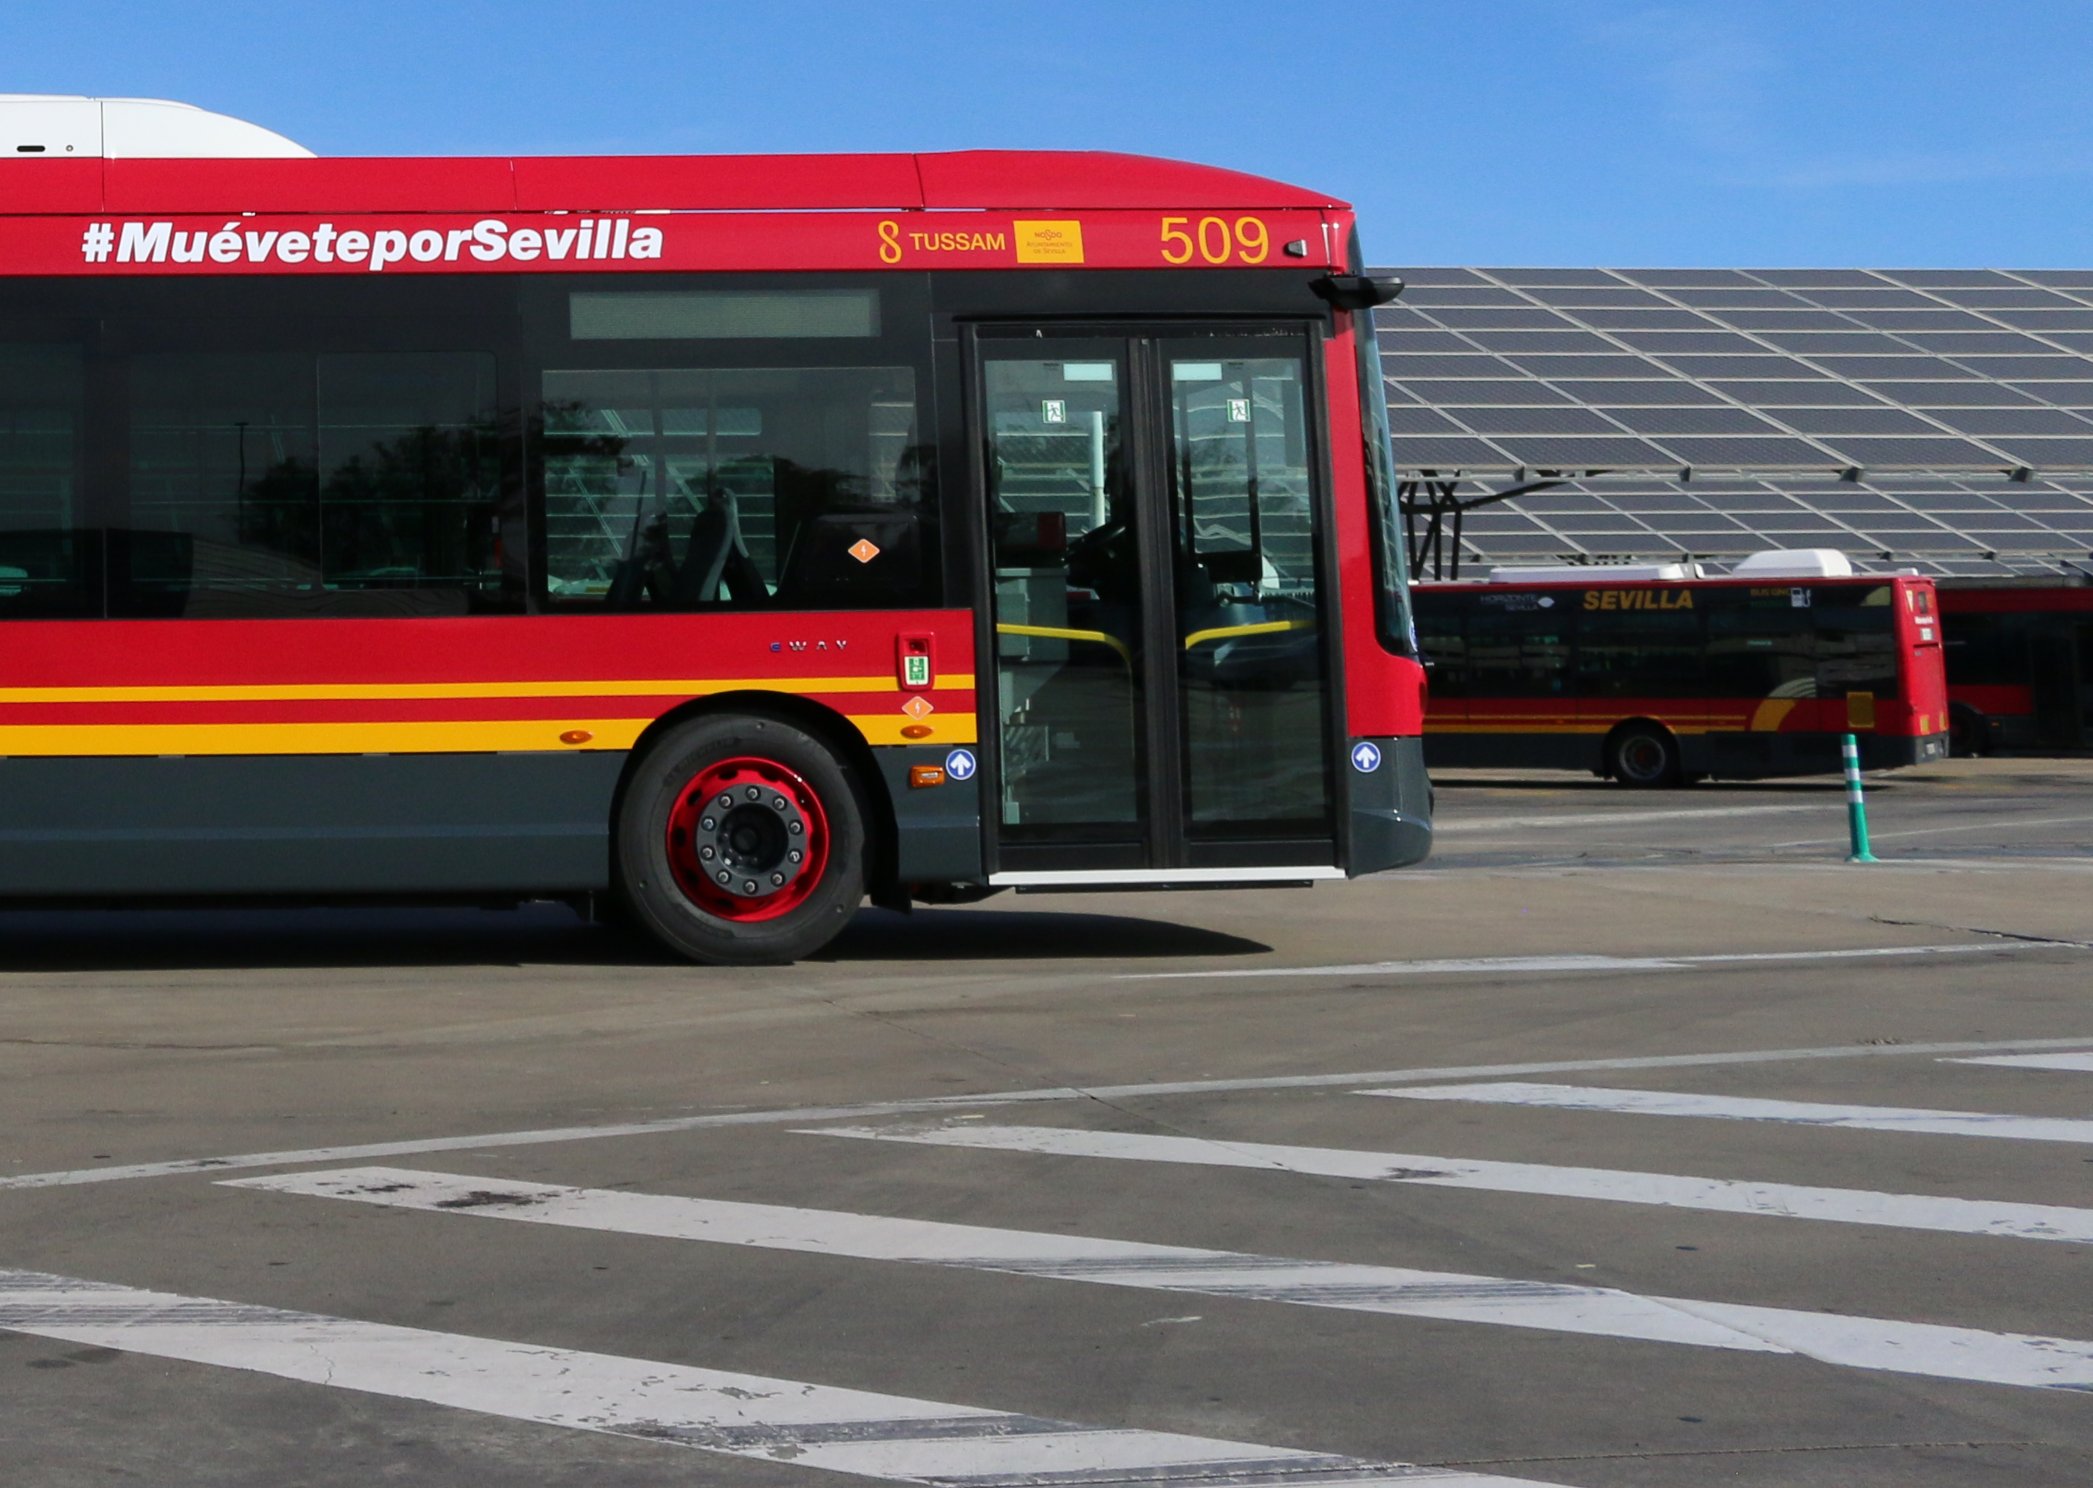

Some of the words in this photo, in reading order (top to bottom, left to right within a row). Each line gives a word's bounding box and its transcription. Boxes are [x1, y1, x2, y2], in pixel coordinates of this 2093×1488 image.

[81, 219, 664, 271] #MuéveteporSevilla
[909, 232, 1007, 252] TUSSAM
[1160, 215, 1270, 265] 509
[1584, 590, 1694, 609] SEVILLA
